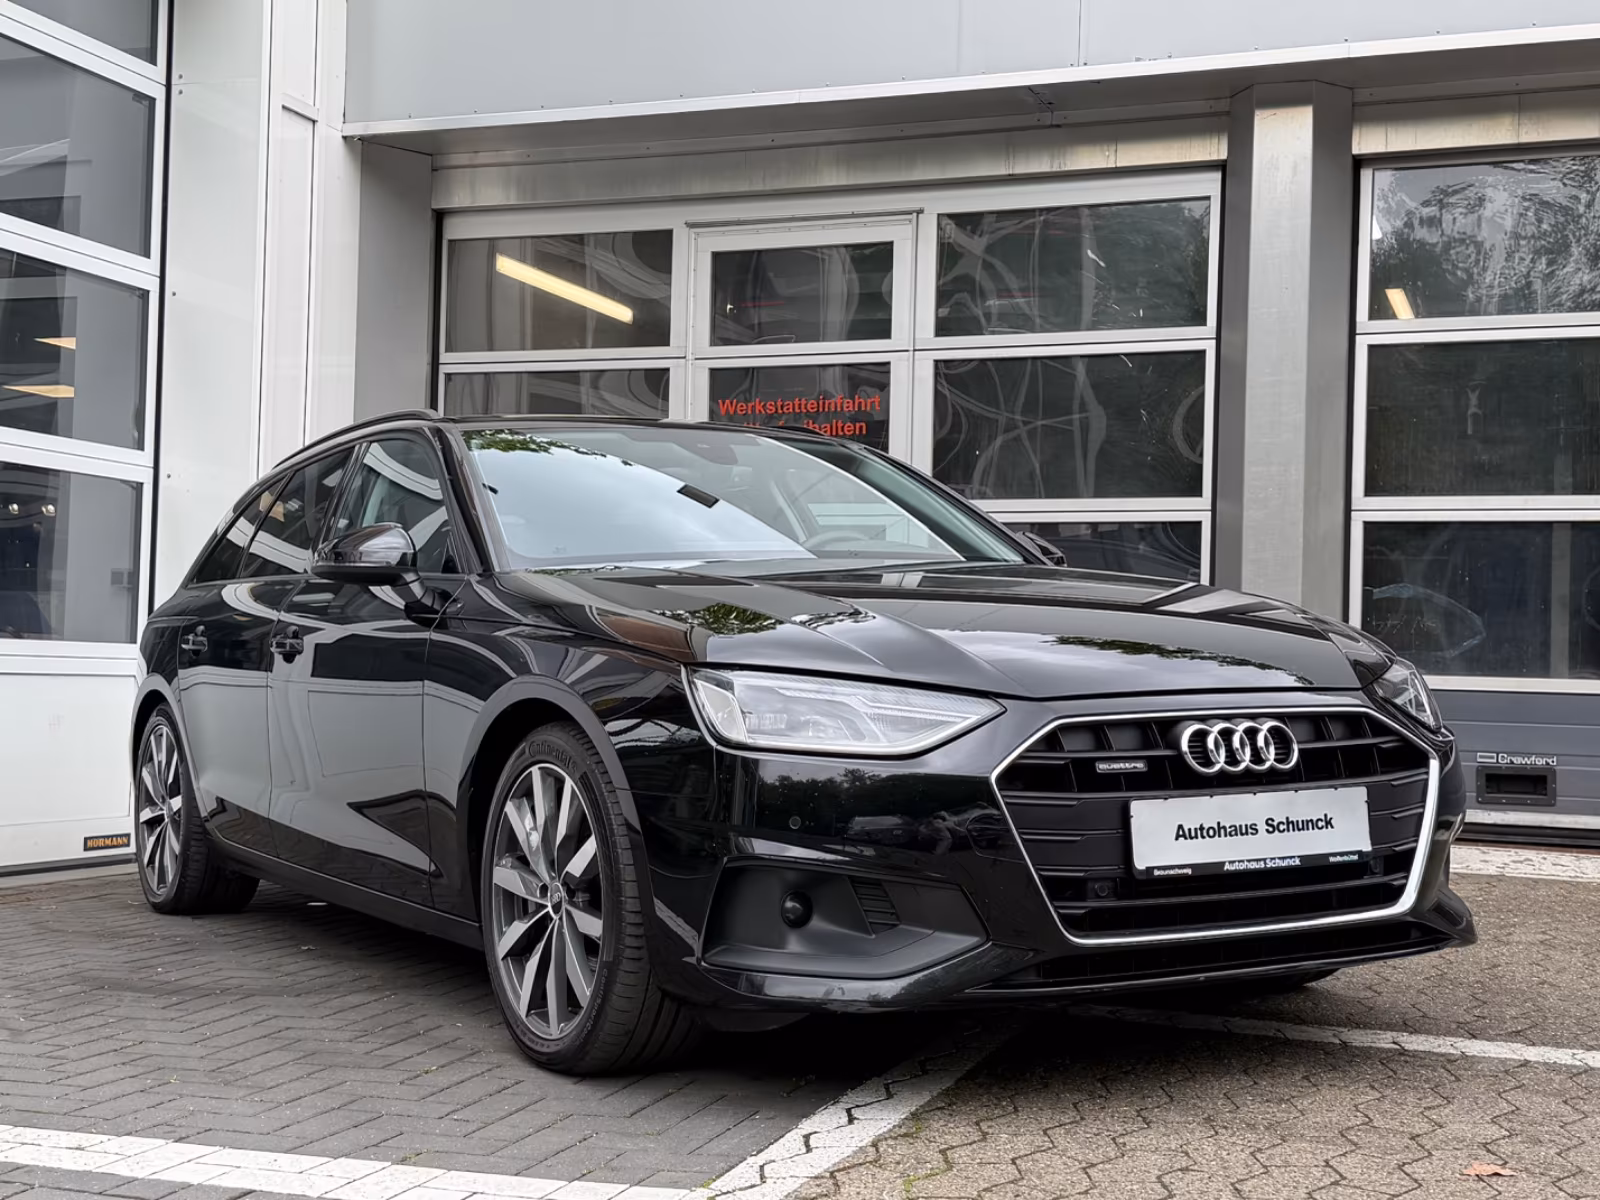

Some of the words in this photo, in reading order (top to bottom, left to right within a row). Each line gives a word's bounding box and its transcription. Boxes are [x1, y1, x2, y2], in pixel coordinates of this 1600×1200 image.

[718, 395, 881, 415] Werkstatteinfahrt
[1498, 753, 1557, 765] Crawford
[1174, 821, 1259, 841] Autohaus
[1264, 812, 1335, 835] Schunck
[1223, 859, 1265, 871] Autohaus
[1265, 856, 1301, 868] Schunck
[1153, 868, 1192, 876] Braunschweig
